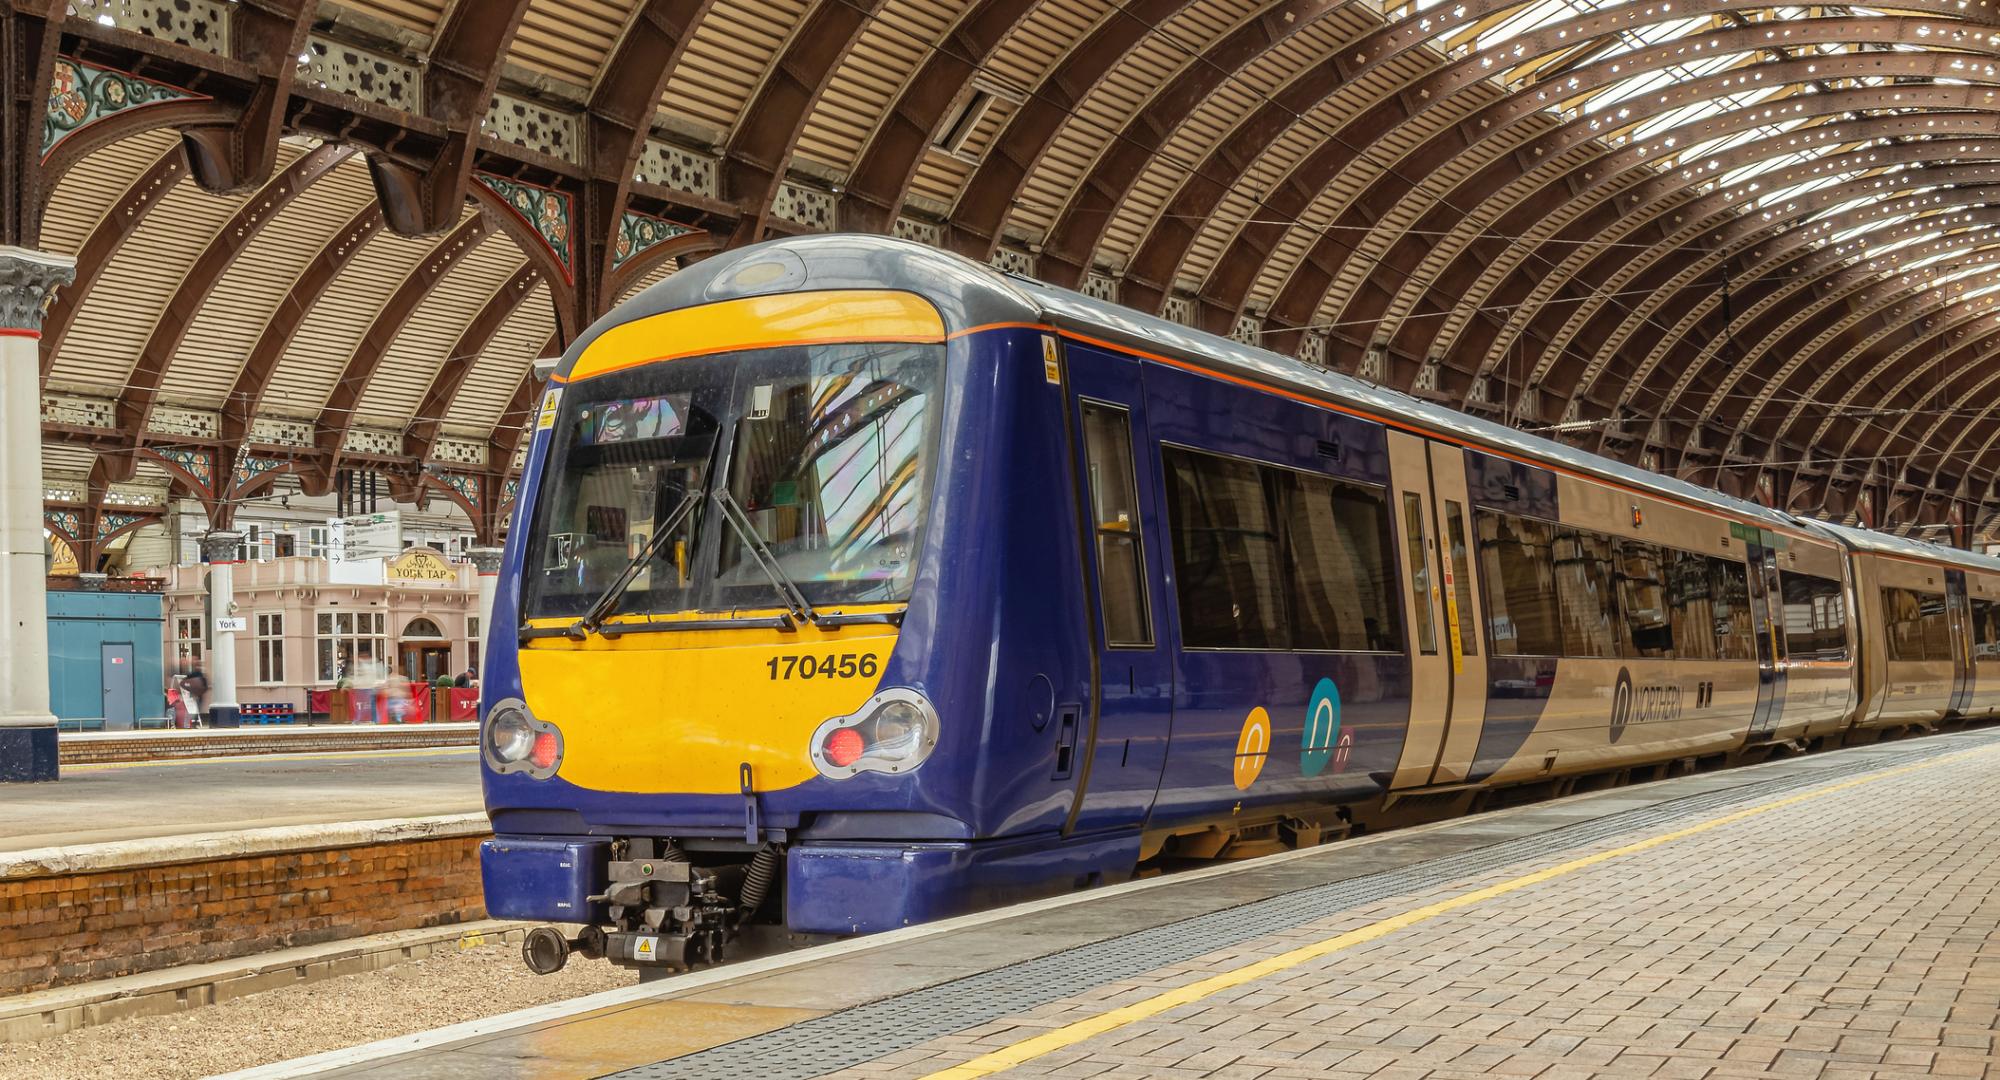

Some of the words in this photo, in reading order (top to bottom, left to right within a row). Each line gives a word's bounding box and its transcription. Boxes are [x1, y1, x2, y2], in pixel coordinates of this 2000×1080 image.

[428, 569, 447, 579] TAP
[219, 620, 236, 628] York
[767, 653, 878, 681] 170456
[1631, 686, 1684, 721] NORTHERN
